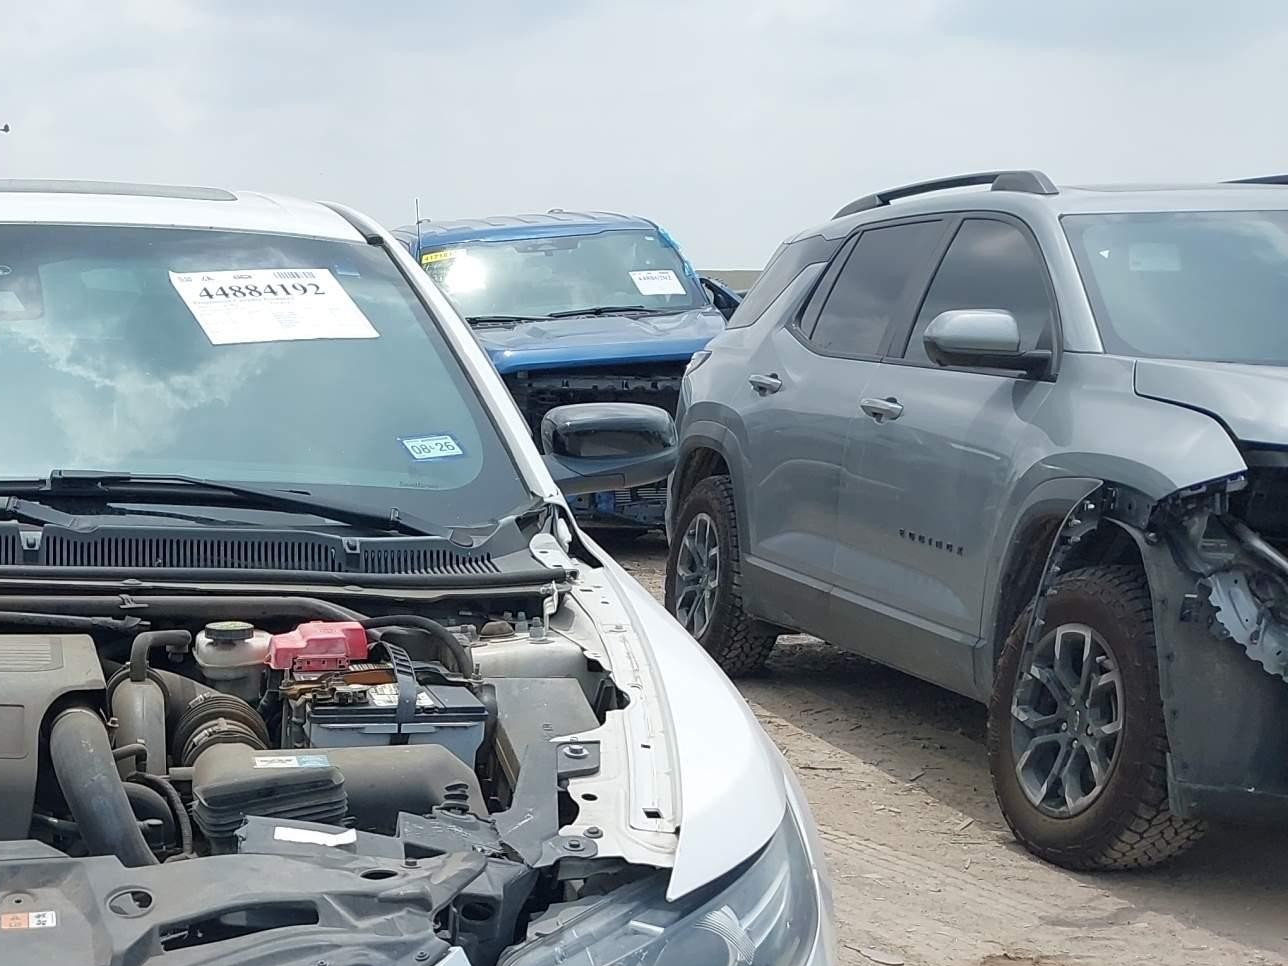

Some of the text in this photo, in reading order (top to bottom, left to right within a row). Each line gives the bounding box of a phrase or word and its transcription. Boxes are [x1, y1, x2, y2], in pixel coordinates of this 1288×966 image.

[199, 283, 326, 300] 44884192
[410, 441, 456, 455] 08 26
